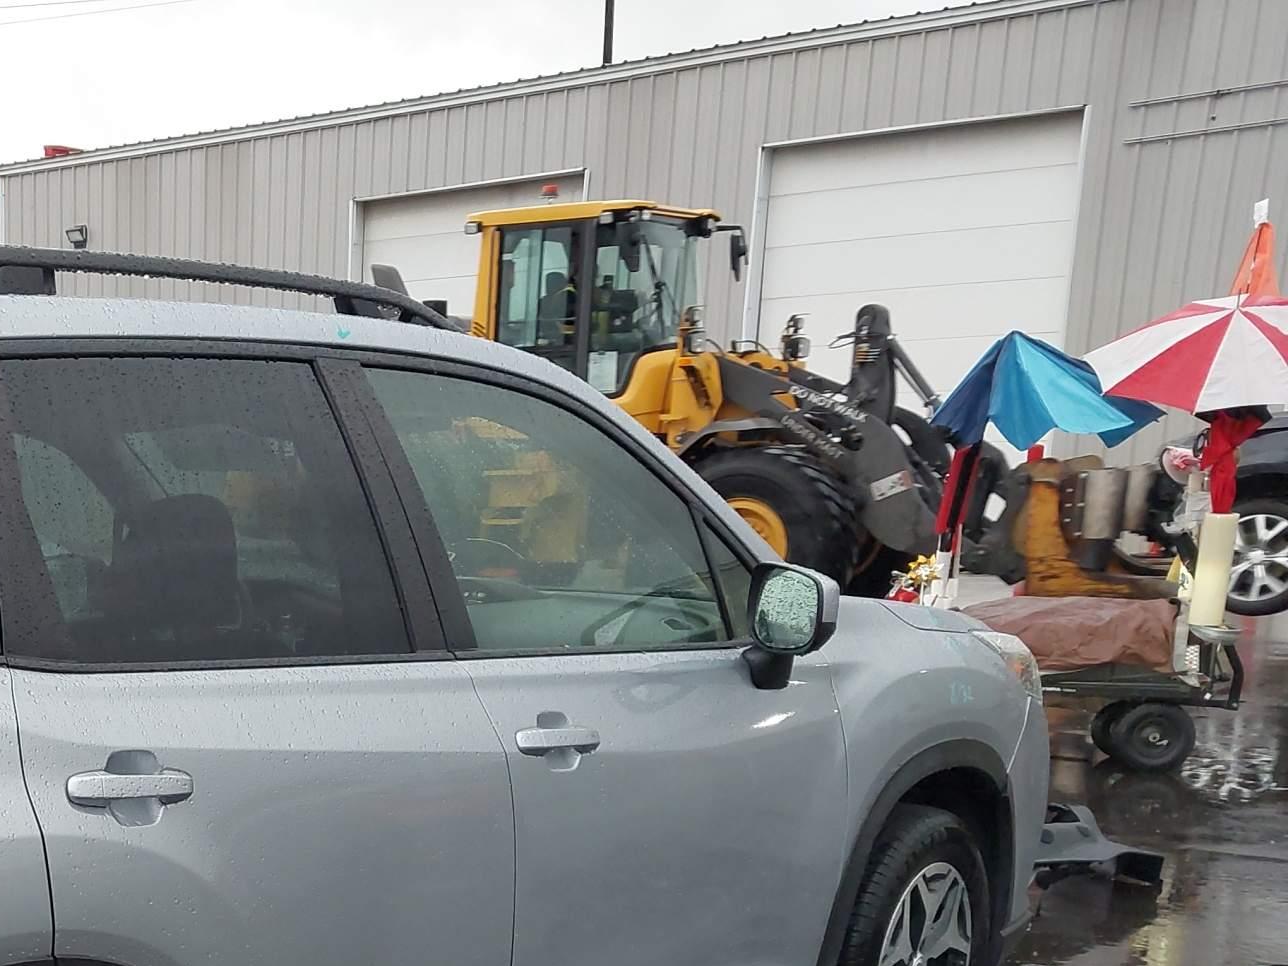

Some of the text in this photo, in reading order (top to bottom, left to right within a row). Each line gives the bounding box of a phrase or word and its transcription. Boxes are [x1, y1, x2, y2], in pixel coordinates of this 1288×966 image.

[788, 386, 869, 423] DO NOT WALK
